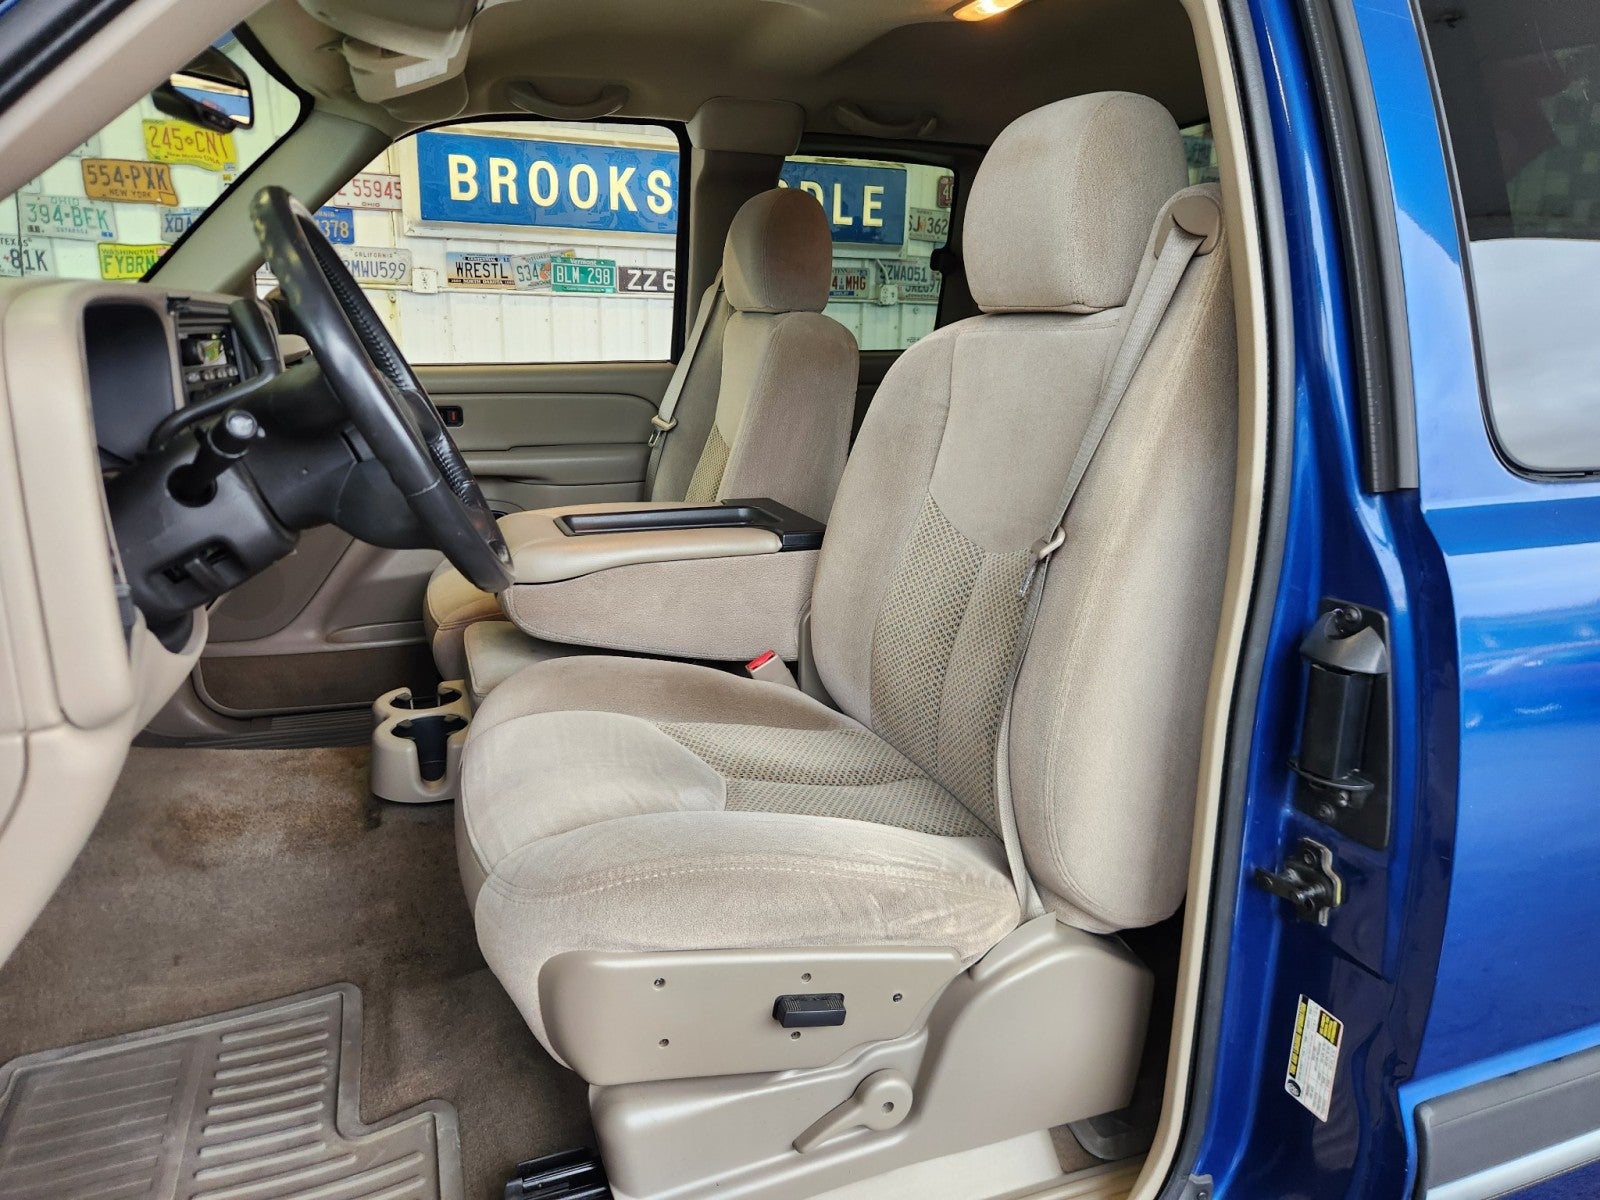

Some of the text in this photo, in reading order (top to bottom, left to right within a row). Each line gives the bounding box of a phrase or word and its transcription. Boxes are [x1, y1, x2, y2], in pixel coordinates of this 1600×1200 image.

[448, 154, 673, 215] BROOKS
[109, 188, 151, 198] NEW YORK
[926, 217, 948, 235] 362
[101, 247, 154, 256] WASHINGTON
[354, 251, 393, 259] CALIFORNIA
[570, 257, 597, 266] Vermont
[455, 261, 509, 279] WRESTL
[588, 267, 611, 285] 298
